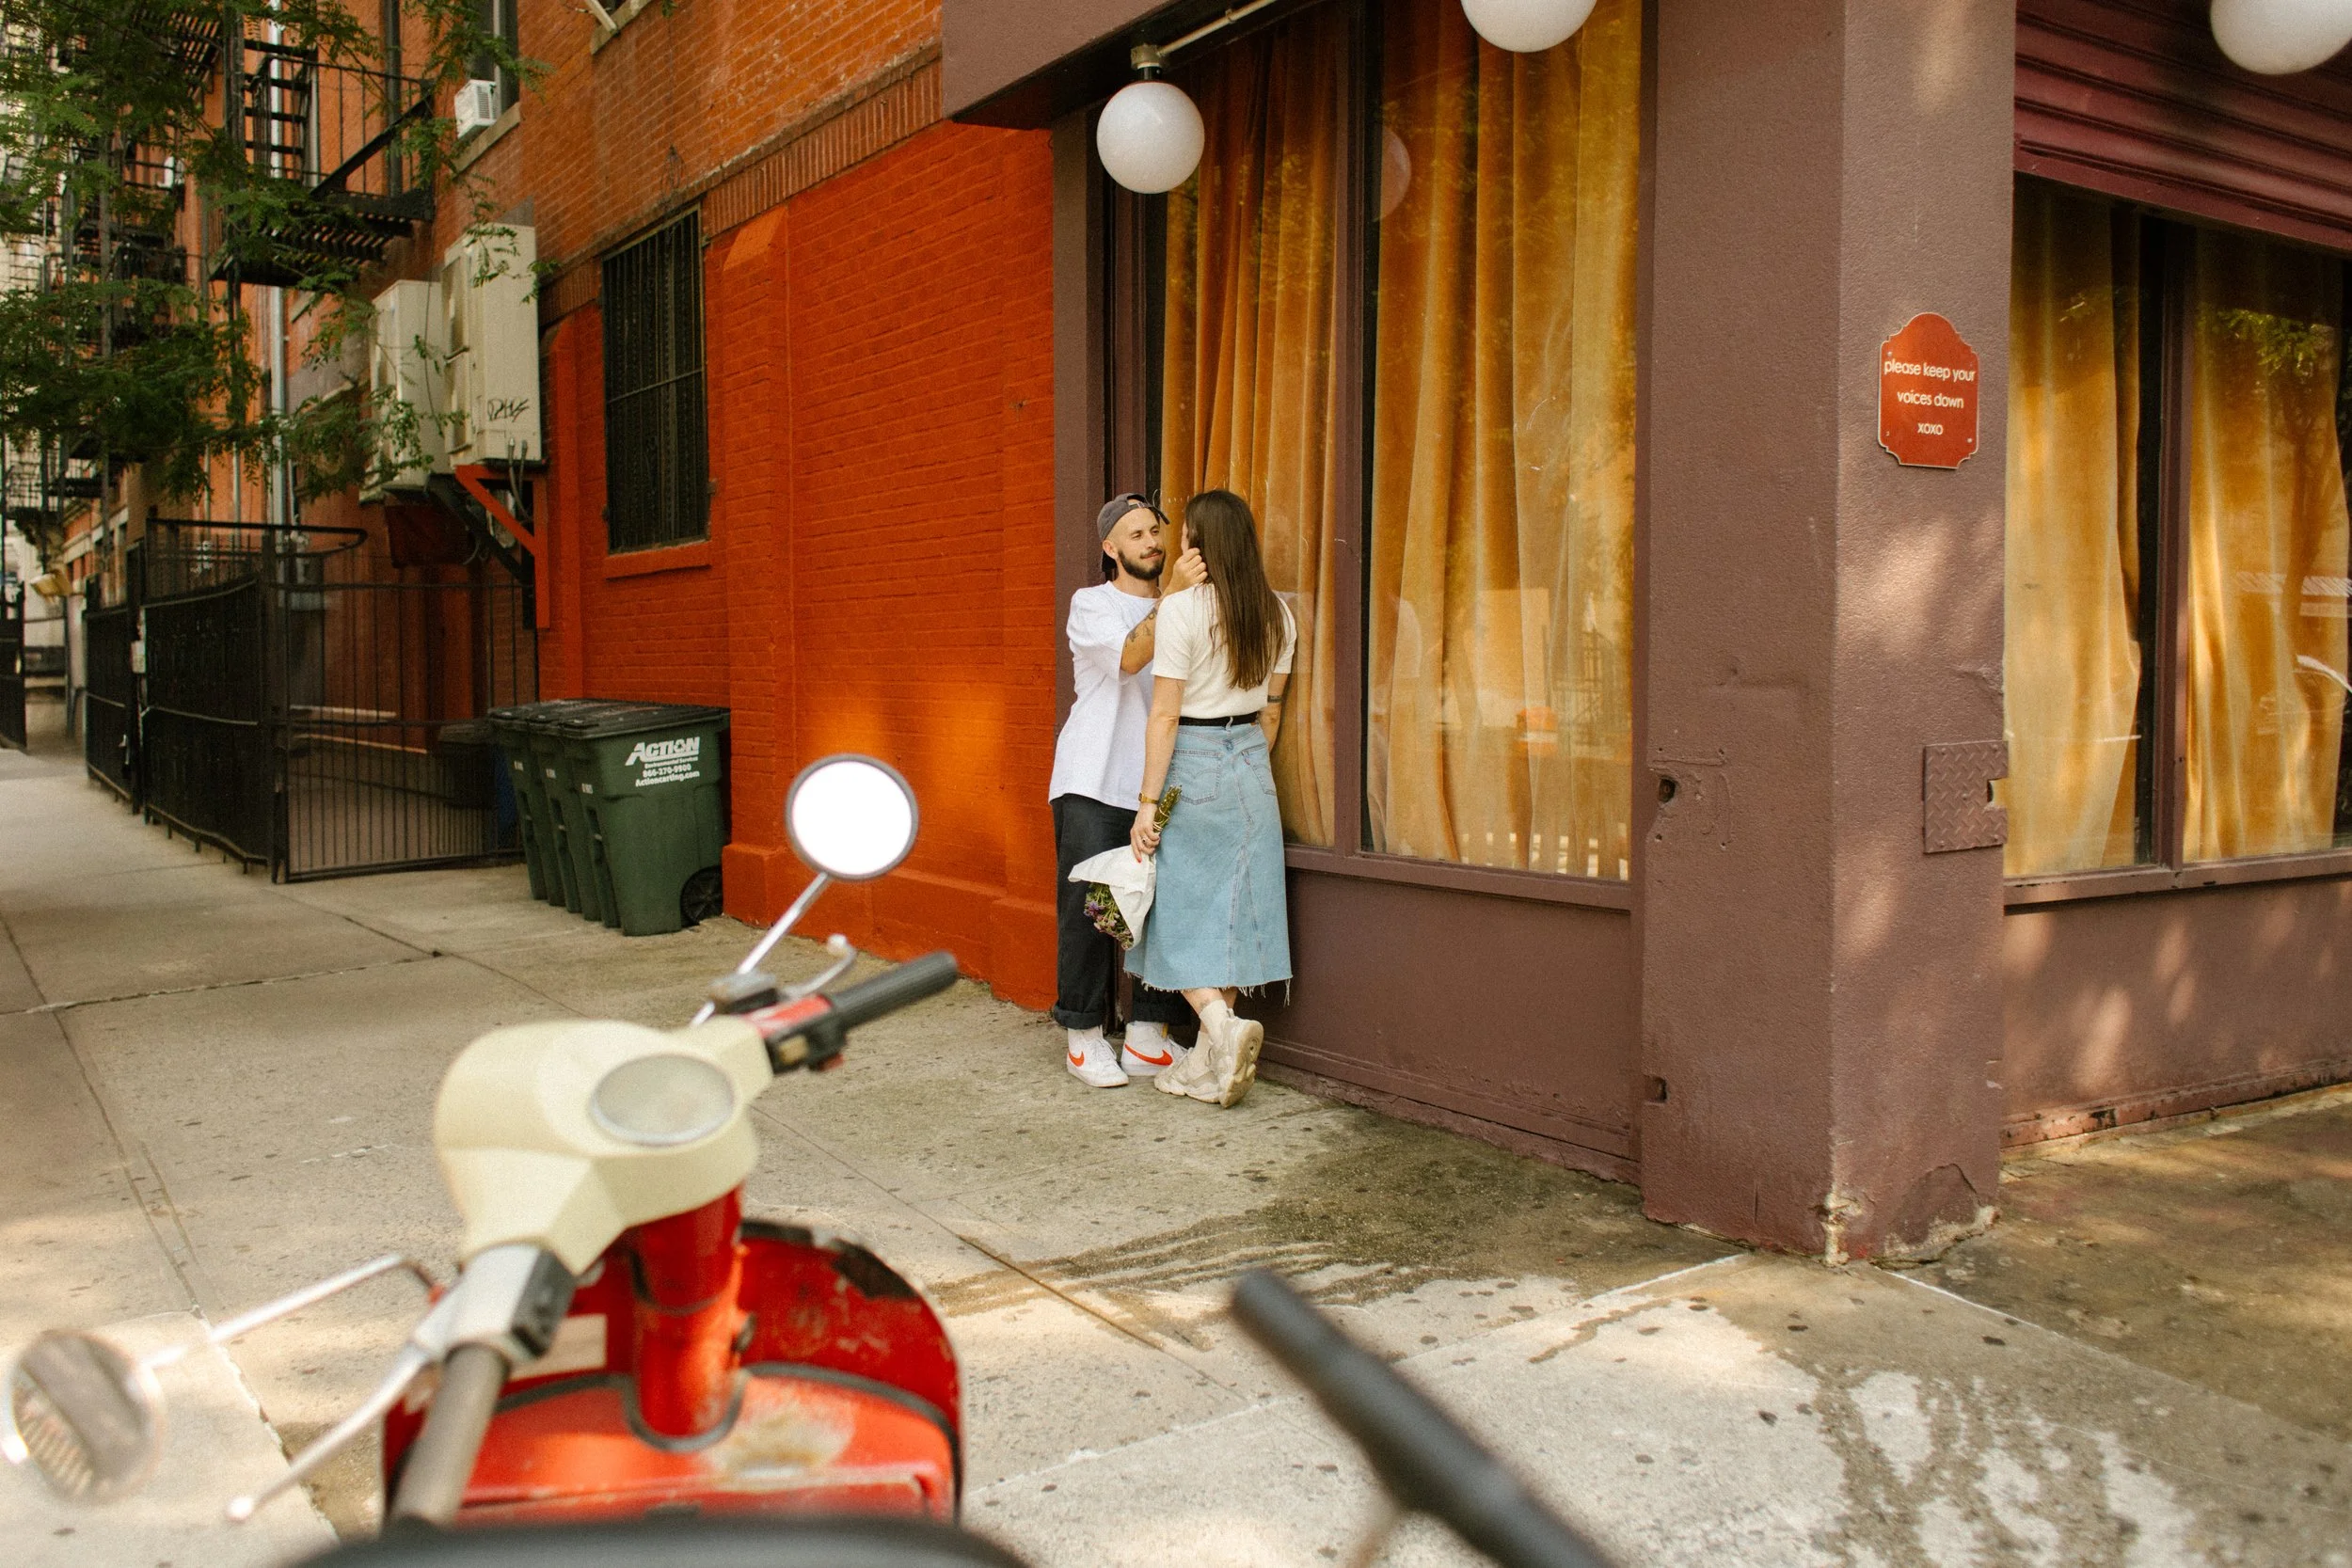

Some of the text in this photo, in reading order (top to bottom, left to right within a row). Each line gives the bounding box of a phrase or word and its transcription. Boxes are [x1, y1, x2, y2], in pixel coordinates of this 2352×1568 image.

[1883, 358, 1976, 383] please keep your
[1897, 389, 1964, 408] voices down
[1917, 422, 1944, 435] xoxo
[625, 736, 700, 766] ACTION
